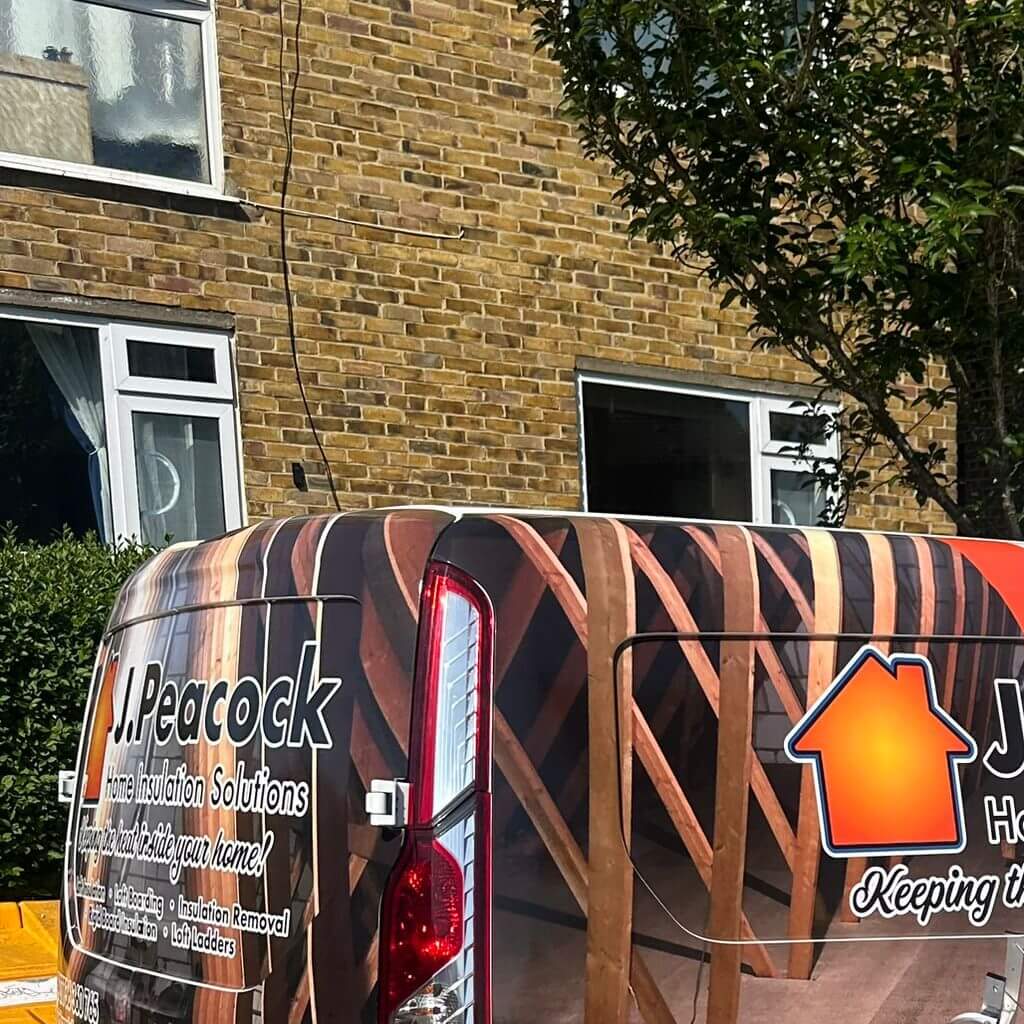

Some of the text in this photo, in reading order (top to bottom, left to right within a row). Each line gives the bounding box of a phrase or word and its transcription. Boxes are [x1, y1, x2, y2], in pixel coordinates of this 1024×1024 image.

[113, 641, 340, 748] J.Peacock
[107, 759, 308, 816] Home Insulation Solutions
[138, 822, 175, 865] inside
[170, 835, 210, 884] your
[211, 830, 274, 877] home!
[127, 887, 164, 920] Boarding
[178, 894, 290, 938] Insulation Removal
[850, 863, 999, 926] Keeping
[171, 922, 235, 958] Loft Ladders
